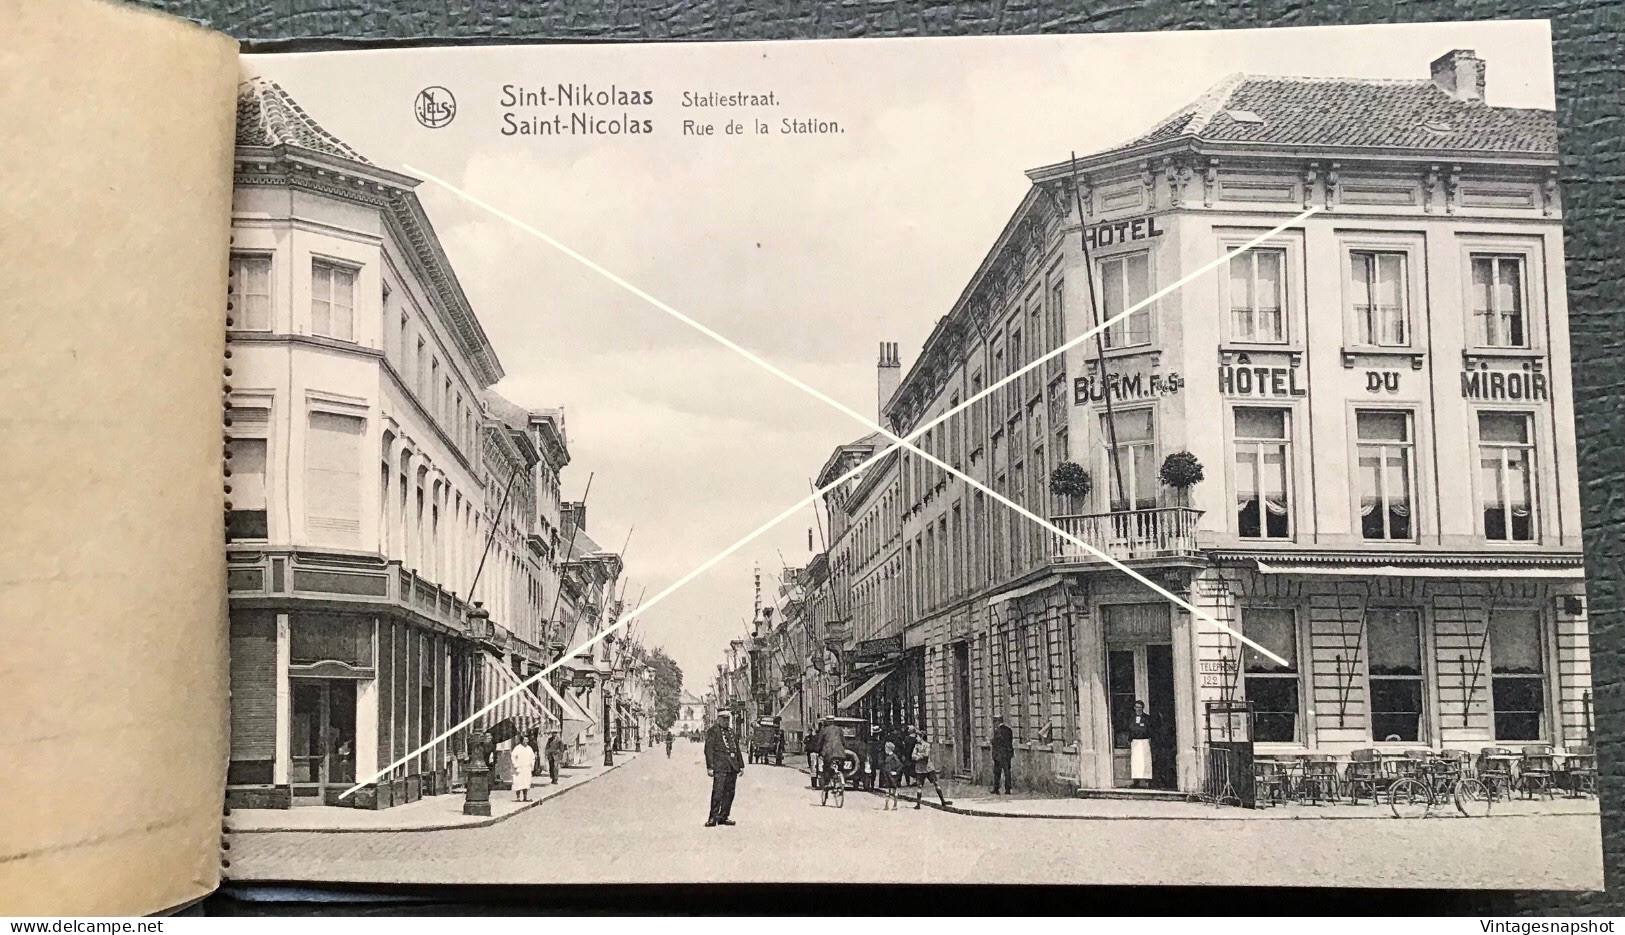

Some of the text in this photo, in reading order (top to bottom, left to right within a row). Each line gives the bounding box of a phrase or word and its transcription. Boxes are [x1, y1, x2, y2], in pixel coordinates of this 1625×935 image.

[500, 83, 654, 107] Sint-Nikolaas
[681, 91, 780, 107] Statiestraat.
[500, 112, 654, 136] Saint-Nicolas
[683, 118, 845, 135] Rue de la Station.
[1365, 371, 1401, 394] DU
[1203, 676, 1218, 685] 122
